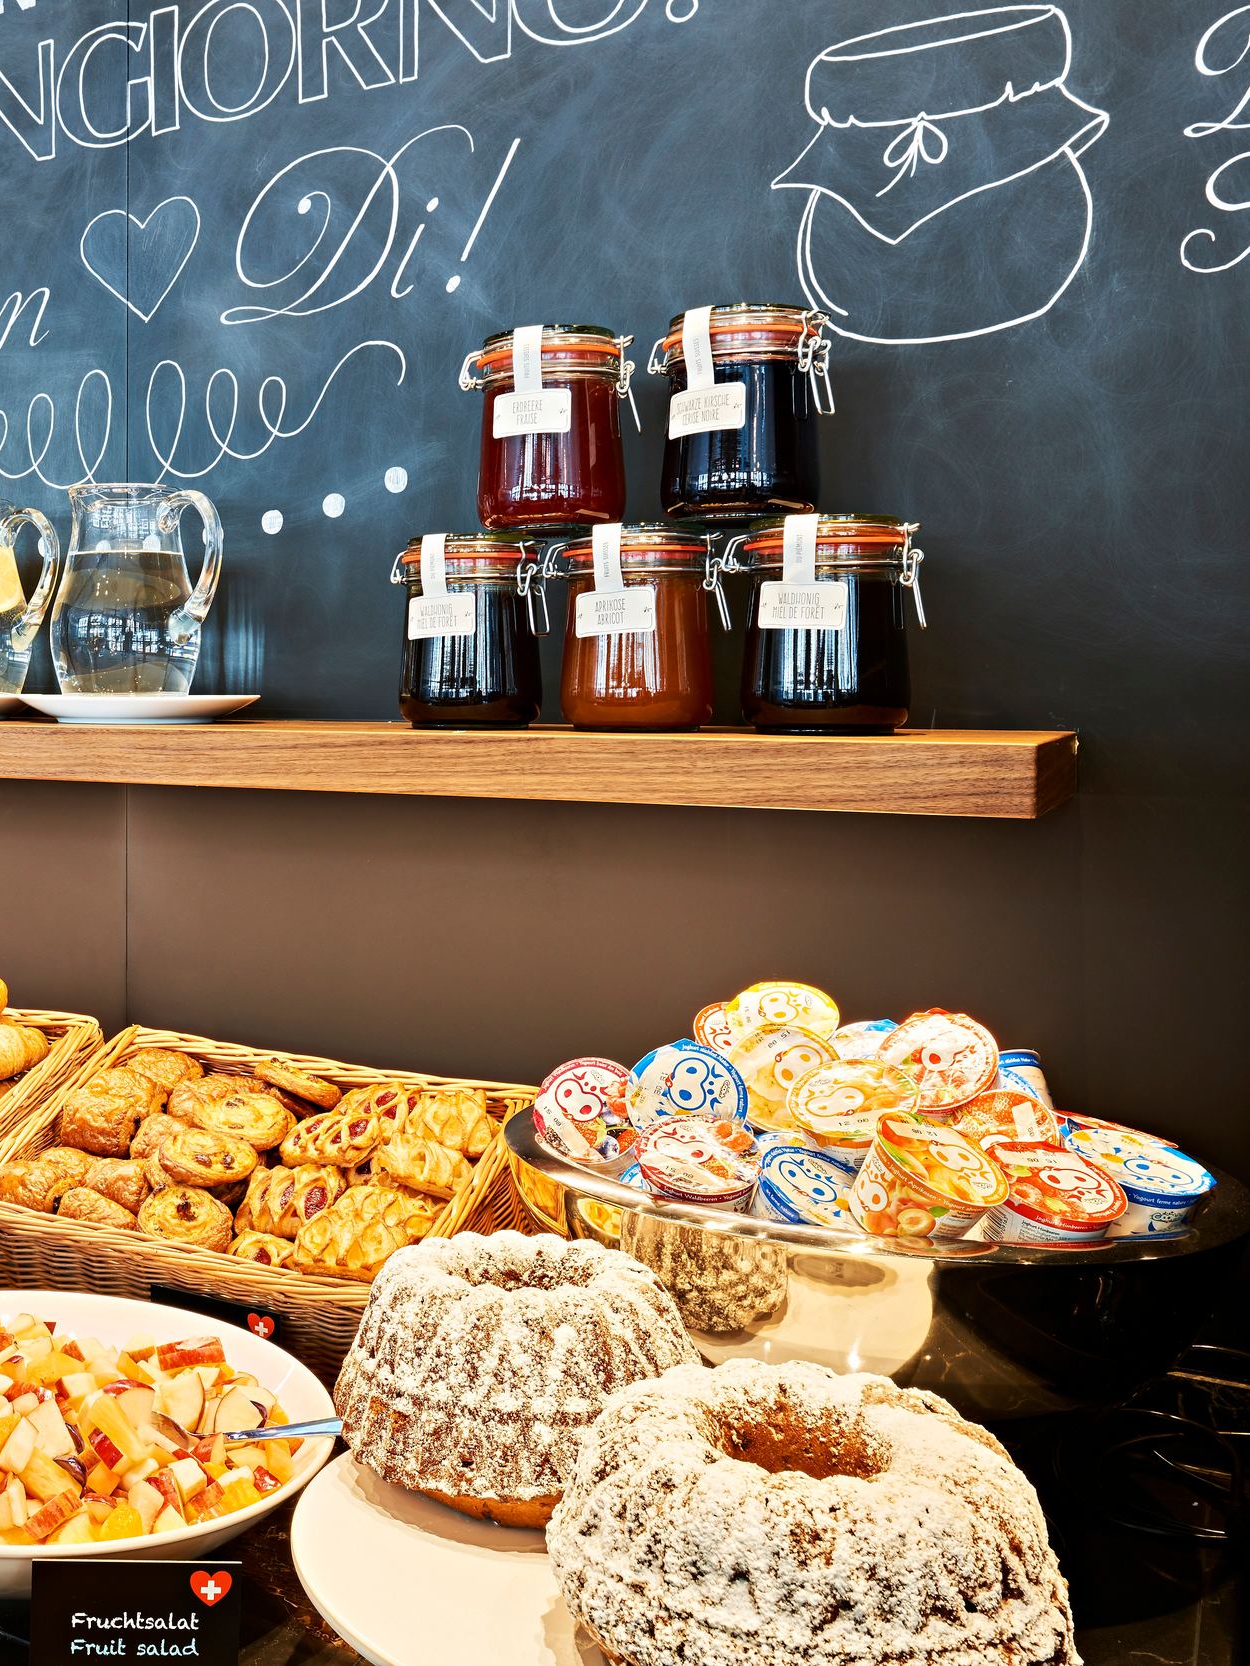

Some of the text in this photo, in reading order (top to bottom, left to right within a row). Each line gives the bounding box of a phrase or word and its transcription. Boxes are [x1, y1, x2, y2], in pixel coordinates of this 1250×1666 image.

[512, 399, 543, 414] ERDBEERE
[704, 394, 730, 409] KIRSCHE
[516, 412, 538, 425] FRAISE
[701, 408, 719, 422] NOIRE
[595, 598, 626, 613] APRIKOSE
[772, 606, 786, 619] MIEL
[788, 606, 798, 618] DE
[597, 612, 624, 625] ABRICOT
[888, 1163, 909, 1182] Joghurt
[907, 1179, 936, 1201] Aprikosen
[661, 1185, 682, 1198] Joghurt
[683, 1193, 717, 1201] Waldbeeren
[1131, 1192, 1155, 1203] Yogourt
[71, 1611, 199, 1630] Fruchtsalat
[70, 1638, 199, 1656] Fruit salad
